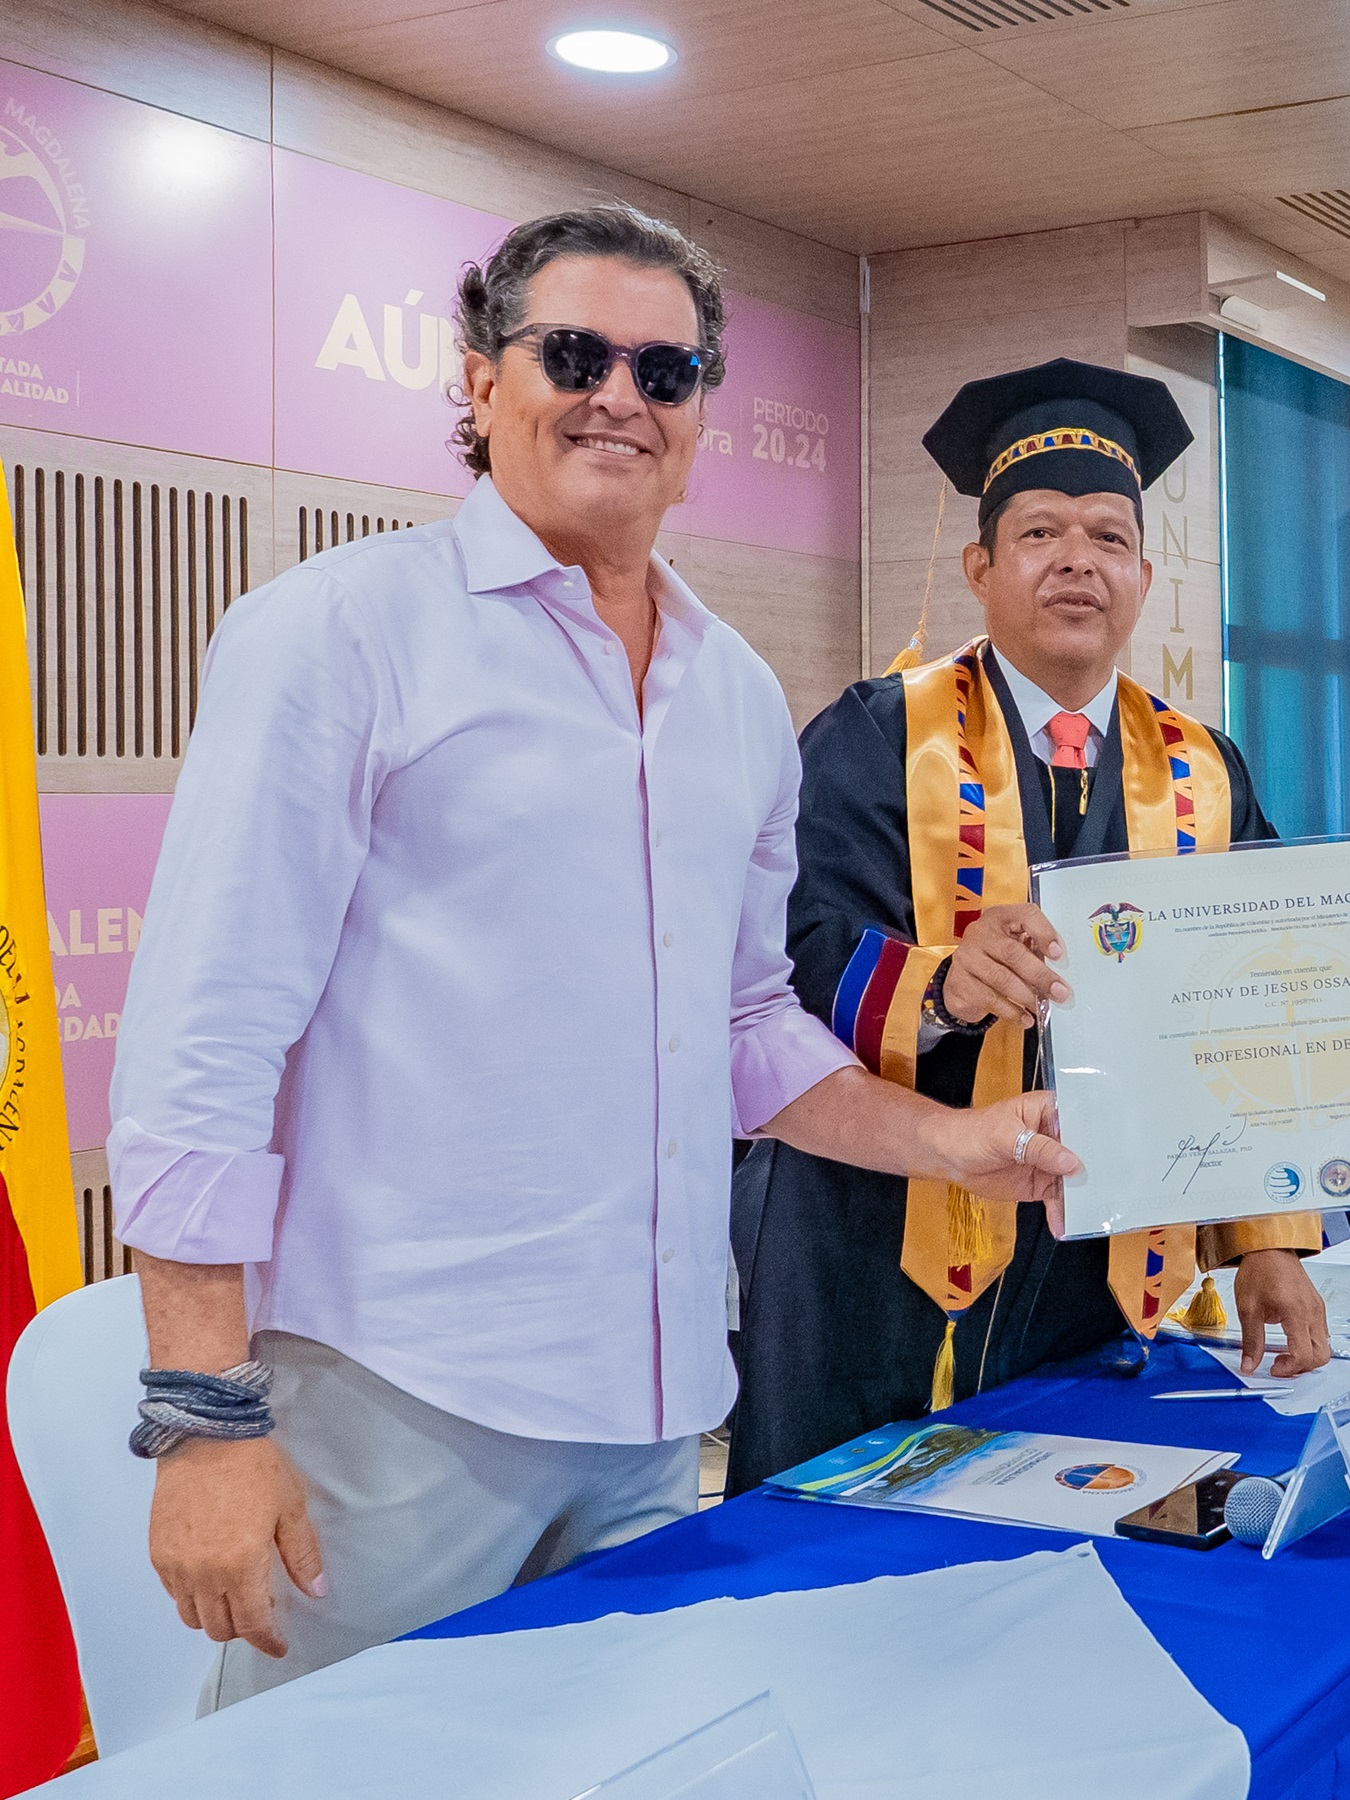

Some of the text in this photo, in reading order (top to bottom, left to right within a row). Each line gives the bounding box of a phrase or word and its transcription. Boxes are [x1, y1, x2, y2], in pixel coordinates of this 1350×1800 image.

[753, 396, 829, 435] PERIODO
[752, 423, 827, 473] 20.24
[1148, 909, 1167, 921] LA
[1172, 898, 1280, 919] UNIVERSIDAD
[1284, 895, 1315, 909] DEL
[1249, 968, 1282, 978] Teniendo
[1293, 965, 1317, 974] cuenta
[1170, 987, 1234, 1003] ANTONY
[1239, 984, 1259, 997] DE
[1262, 980, 1308, 996] JESUS
[1312, 975, 1350, 989] OSSA
[58, 1012, 121, 1042] DAD
[1193, 1043, 1301, 1064] PROFESIONAL
[1305, 1040, 1326, 1053] EN
[1199, 1159, 1223, 1168] Rector
